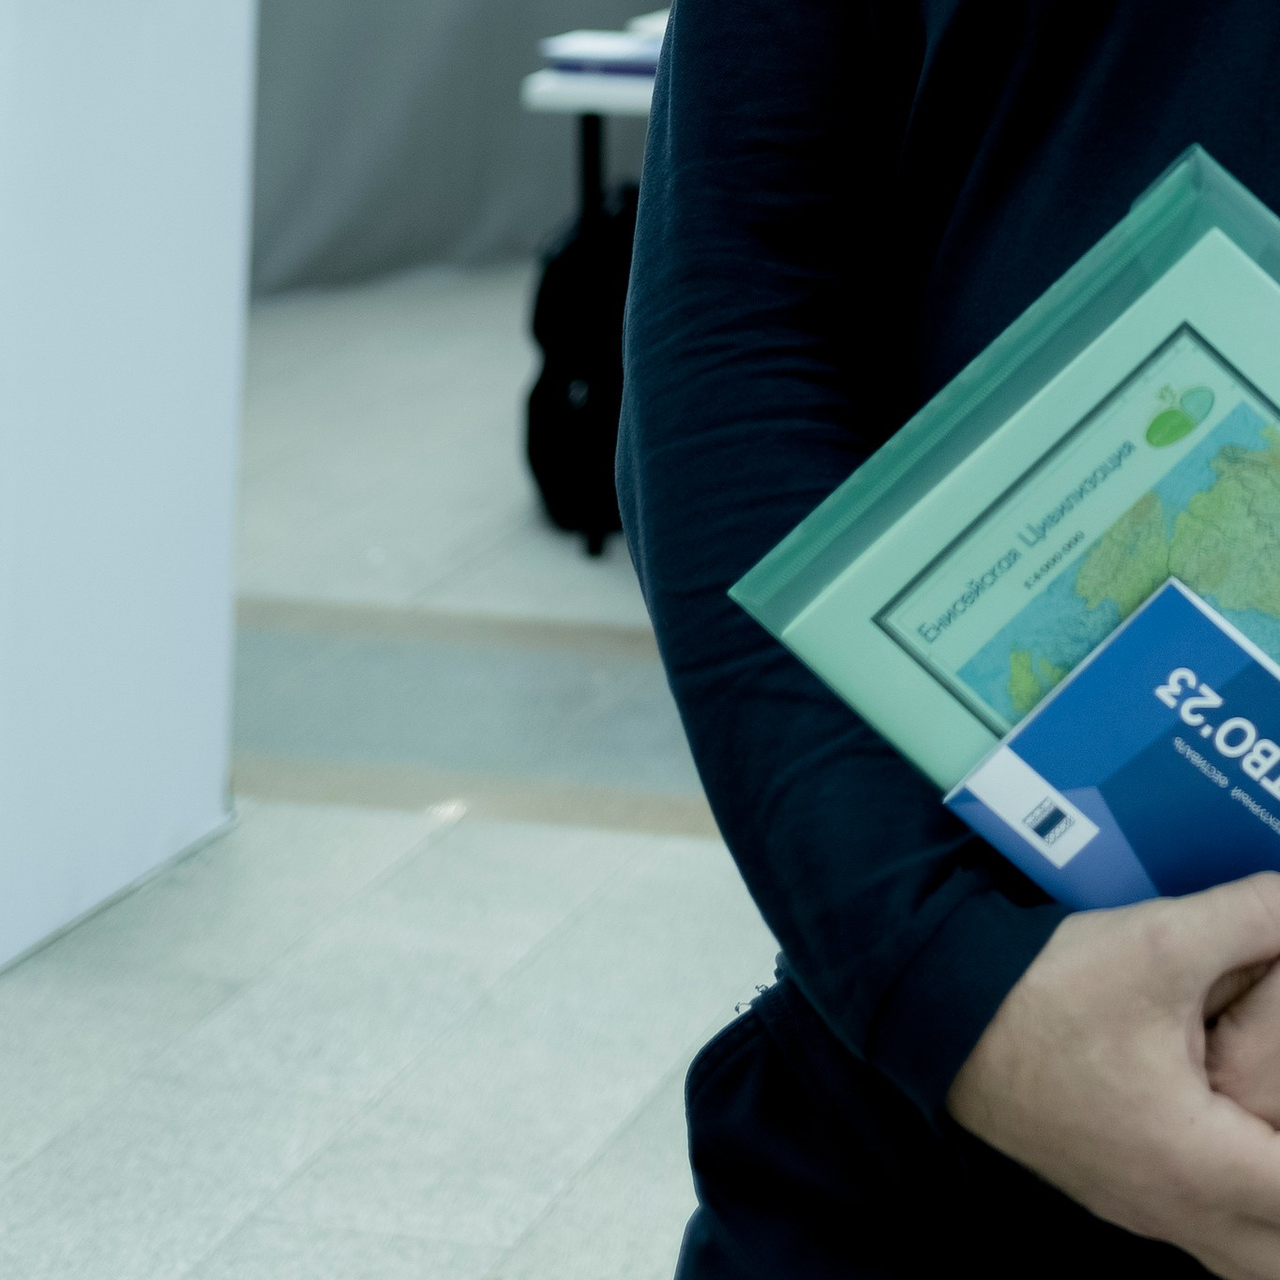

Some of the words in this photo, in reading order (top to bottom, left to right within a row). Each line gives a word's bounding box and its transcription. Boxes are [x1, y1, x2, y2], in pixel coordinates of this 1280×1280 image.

[917, 548, 1022, 644] Енисейская
[1018, 439, 1137, 549] Цивилизация
[1173, 736, 1229, 788] ФЕСТИВАЛЬ
